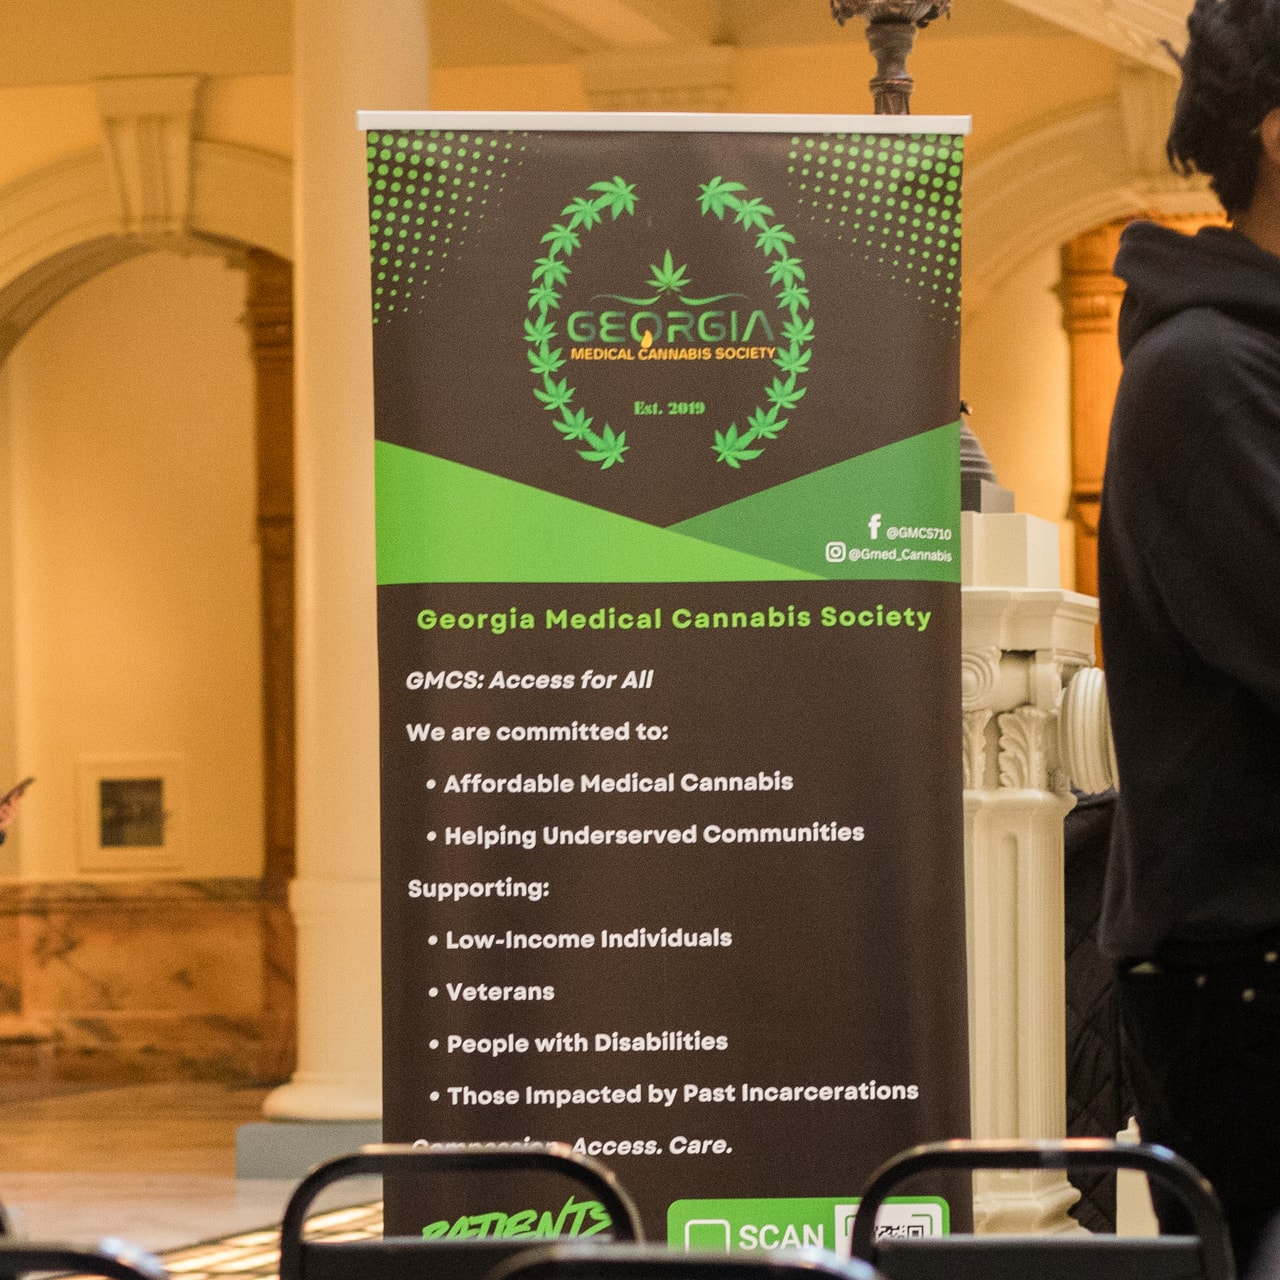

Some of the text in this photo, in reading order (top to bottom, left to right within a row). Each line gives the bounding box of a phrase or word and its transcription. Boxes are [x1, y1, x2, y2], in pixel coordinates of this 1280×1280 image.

[567, 309, 775, 344] GEORGIA
[570, 346, 777, 361] MEDICAL CANNABIS SOCIETY
[633, 401, 706, 416] Est. 2019
[886, 526, 952, 541] @GMCS710
[848, 547, 953, 563] @Gmed_Cannabis
[416, 603, 932, 635] Georgia Medical Cannabis Society
[405, 669, 655, 691] GMCS: Access for All
[405, 720, 669, 742] We are committed to:
[443, 770, 794, 794] Affordable Medical Cannabis
[444, 820, 865, 850] Helping Underserved Communities
[408, 876, 550, 902] Supporting:
[446, 926, 733, 950] Low-Income Individuals
[445, 982, 555, 1002] Veterans
[447, 1030, 729, 1058] People with Disabilities
[446, 1079, 920, 1109] Those Impacted by Past Incarcerations
[571, 1137, 663, 1156] Access.
[668, 1135, 733, 1156] Care.
[738, 1223, 824, 1251] SCAN
